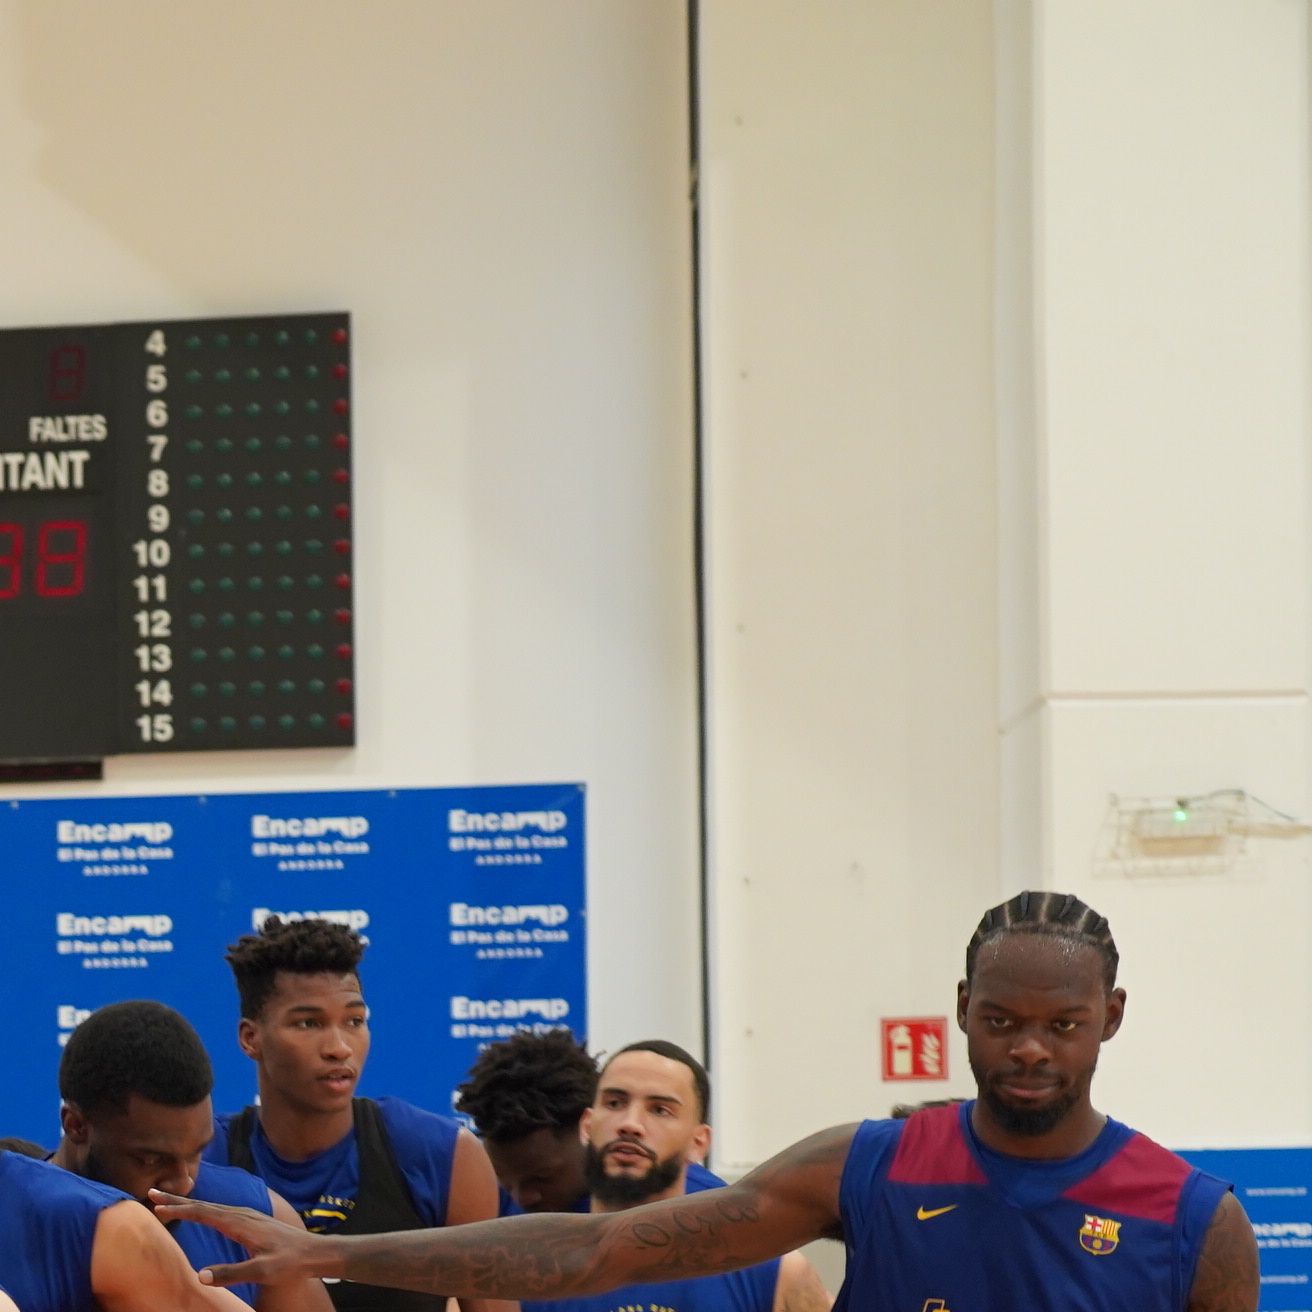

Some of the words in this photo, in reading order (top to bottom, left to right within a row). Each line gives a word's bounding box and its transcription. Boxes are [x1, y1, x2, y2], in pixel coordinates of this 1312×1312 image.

[145, 330, 167, 356] 4
[146, 365, 168, 392] 5
[146, 400, 169, 427] 6
[28, 414, 108, 442] FALTES
[146, 435, 169, 461] 7
[147, 469, 170, 497] 8
[147, 504, 170, 532] 9
[133, 539, 171, 567] 10
[133, 575, 167, 602] 11
[134, 609, 172, 637] 12
[134, 644, 173, 672] 13
[135, 680, 173, 707] 14
[136, 714, 174, 742] 15
[57, 821, 173, 844] Encamp
[252, 815, 368, 838] Encamp
[449, 810, 566, 832] Encamp
[57, 913, 172, 936] Encamp
[450, 903, 568, 926] Encamp
[451, 997, 569, 1020] Encamp
